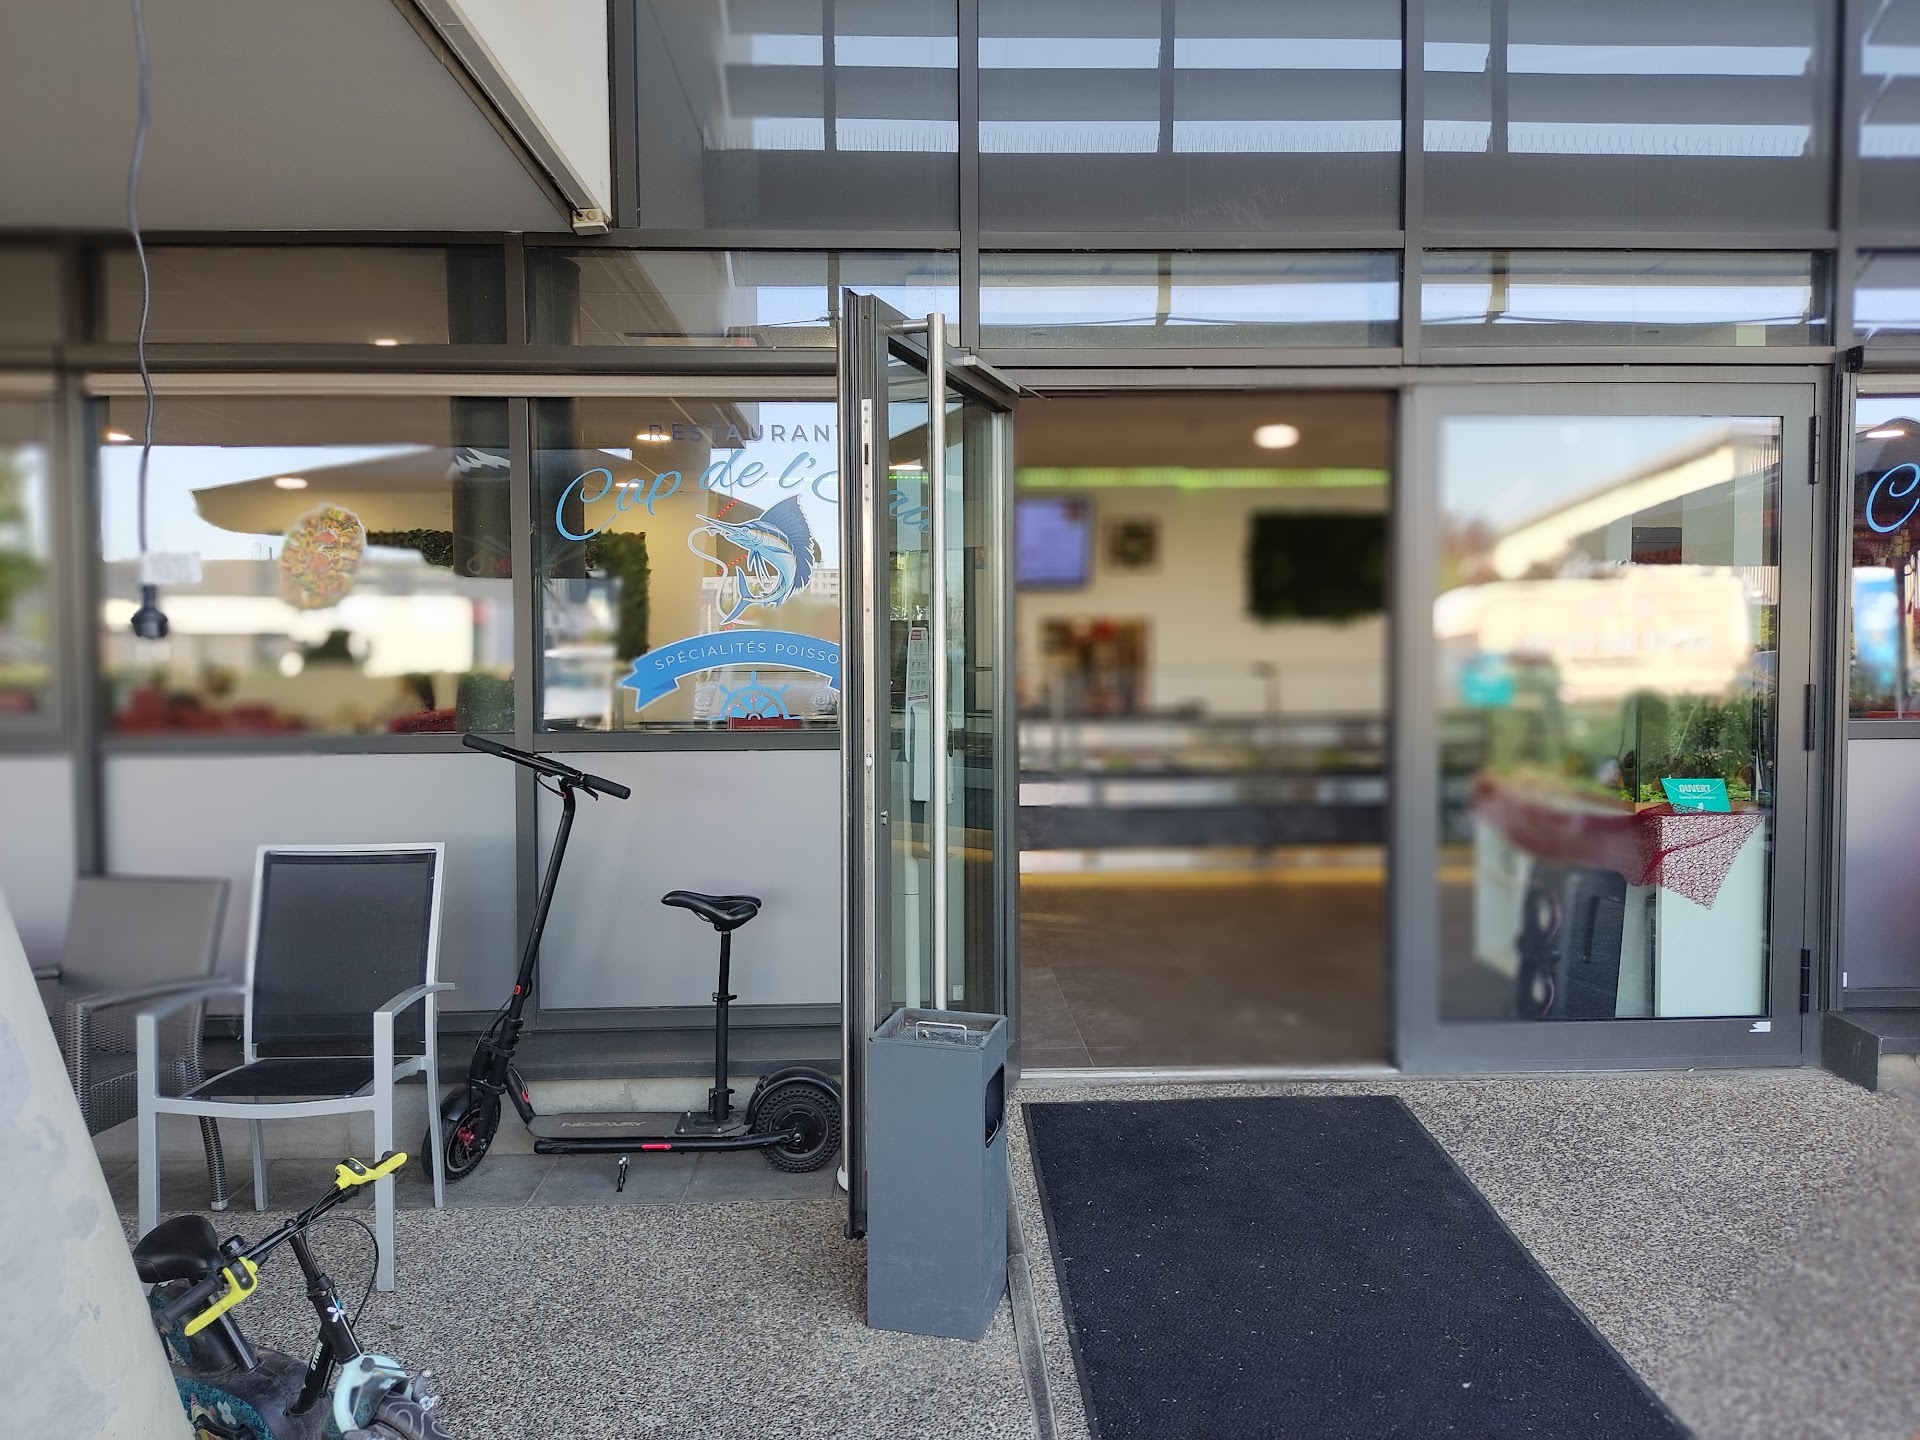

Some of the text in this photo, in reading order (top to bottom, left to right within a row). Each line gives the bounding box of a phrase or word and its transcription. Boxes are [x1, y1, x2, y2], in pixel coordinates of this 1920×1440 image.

[649, 424, 838, 443] RESTAURAN
[555, 467, 682, 541] Cap
[699, 449, 768, 490] de
[655, 641, 767, 670] SPÉCIALITÉS
[1679, 784, 1710, 793] OUVERT
